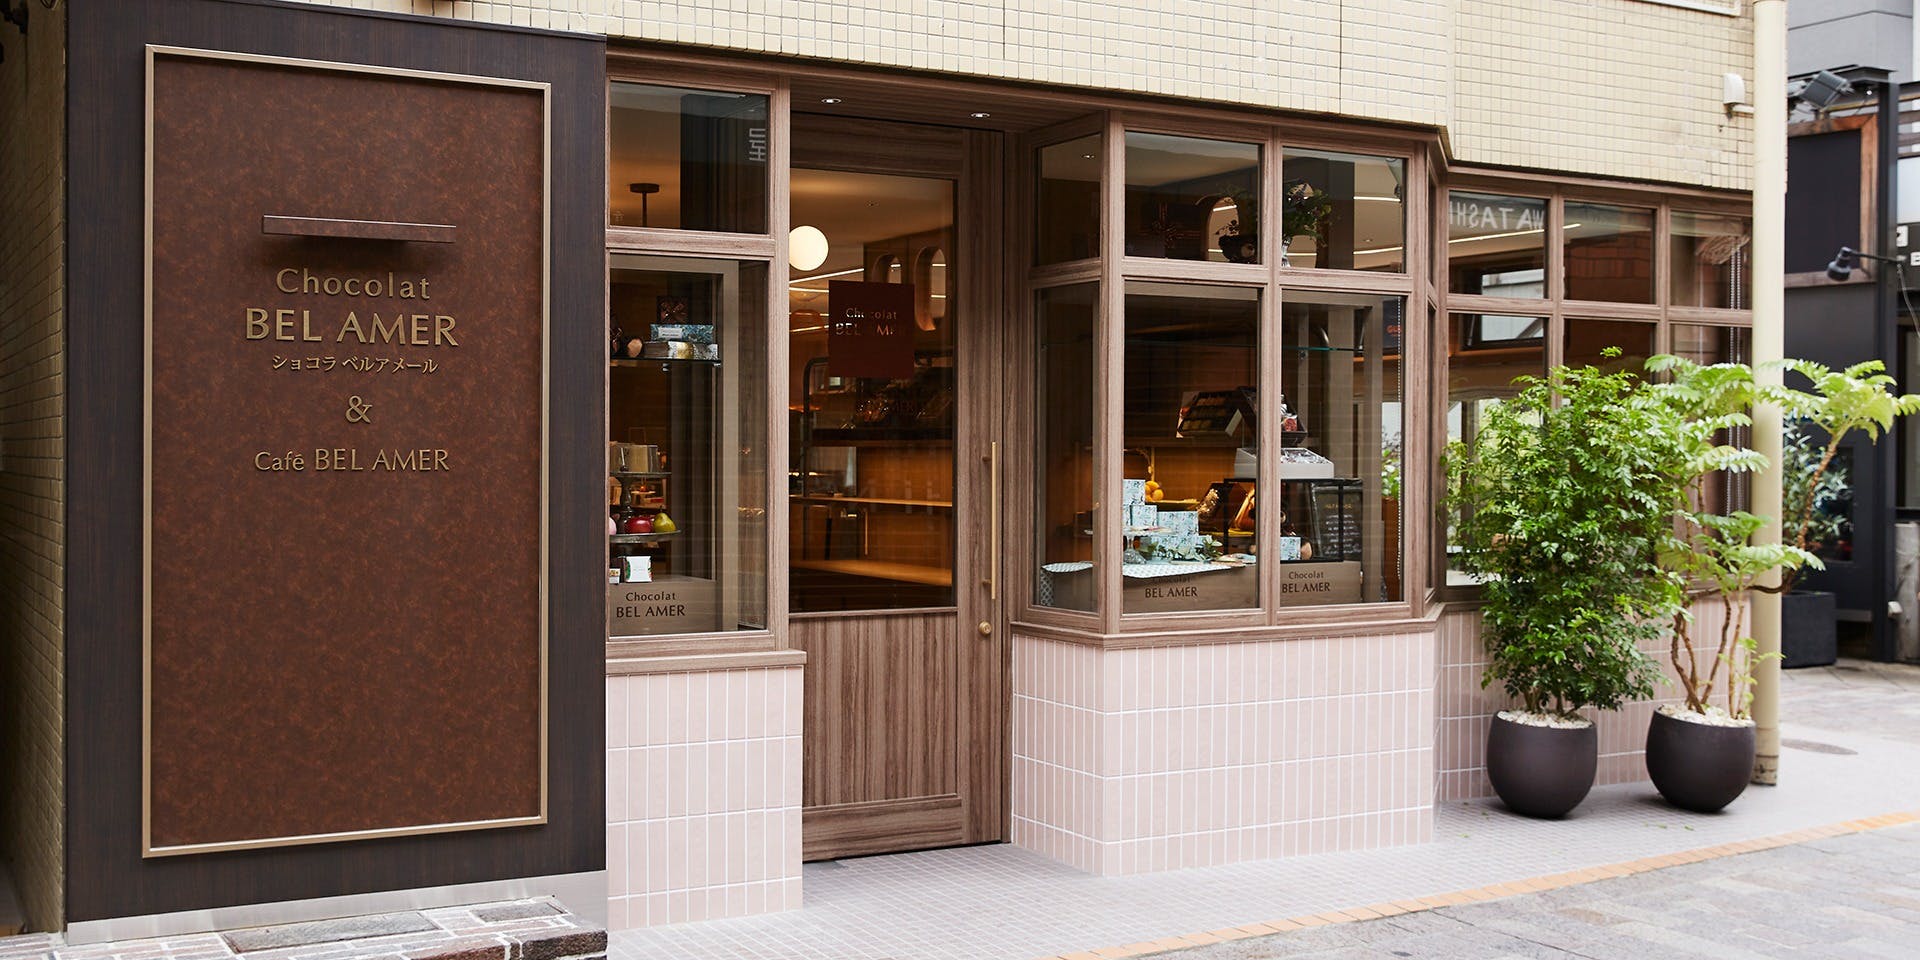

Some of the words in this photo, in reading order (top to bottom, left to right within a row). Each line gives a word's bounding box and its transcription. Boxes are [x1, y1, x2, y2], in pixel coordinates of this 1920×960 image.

[276, 268, 430, 300] Chocolat
[246, 307, 322, 342] BEL
[336, 311, 459, 346] AMER
[272, 355, 337, 371] ショコラ
[342, 356, 439, 374] ベルアメール
[345, 395, 373, 424] &
[255, 451, 305, 472] Café
[315, 448, 364, 471] BEL
[372, 449, 450, 471] AMER
[1288, 571, 1324, 580] Chocolat
[1144, 587, 1164, 598] BEL
[1167, 586, 1198, 597] AMER
[1282, 583, 1300, 593] BEL
[1301, 582, 1330, 593] AMER
[625, 591, 676, 602] Chocolat
[616, 606, 640, 618] BEL
[645, 604, 686, 617] AMER
